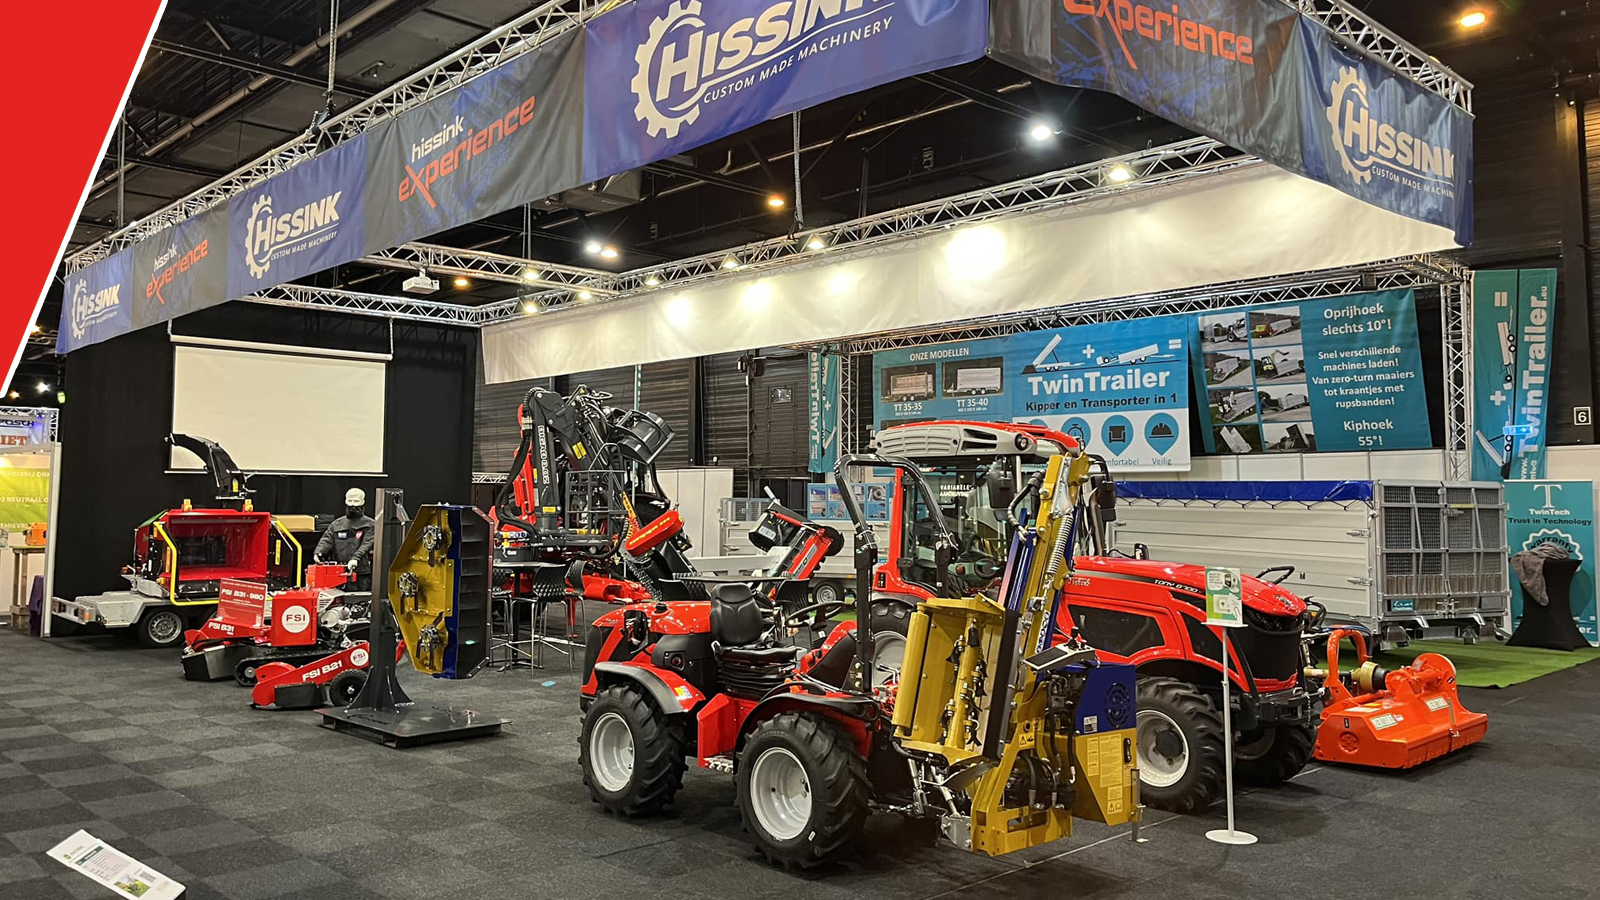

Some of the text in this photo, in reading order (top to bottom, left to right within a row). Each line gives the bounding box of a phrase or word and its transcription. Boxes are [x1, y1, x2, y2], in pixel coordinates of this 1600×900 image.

[655, 0, 882, 102] HISSIN
[703, 16, 893, 103] CUSTOM MADE MACHINERY
[411, 114, 465, 163] hissink
[1371, 165, 1455, 199] CUSTOM MADE MACHIN
[254, 190, 342, 255] HISSINK
[270, 230, 338, 261] CUSTOM MADE MACHINERY
[1323, 303, 1384, 321] Oprijhoek
[1322, 320, 1364, 336] slechts
[909, 347, 970, 362] ONZE MODELLEN
[1318, 345, 1402, 360] Snel verschillende
[1323, 358, 1399, 372] machines laden!
[1027, 367, 1171, 396] TwinTrailer
[1312, 370, 1415, 385] Van zero-turn maaiers
[1323, 383, 1405, 398] tot kraantjes met
[903, 402, 923, 412] 35-35
[967, 397, 989, 407] 35-40
[1026, 393, 1178, 413] Kipper en Transporter in 1
[1335, 397, 1395, 409] rupsbanden!
[1578, 411, 1587, 423] 6
[1343, 419, 1394, 433] Kiphoek
[1106, 458, 1139, 466] mfortabel
[1151, 458, 1172, 467] Veilig
[1528, 508, 1571, 516] TwinTech
[1542, 518, 1592, 526] Technology
[221, 588, 233, 596] FSI
[208, 621, 220, 630] FSI
[286, 614, 306, 622] FSI
[302, 660, 343, 682] FSI B21
